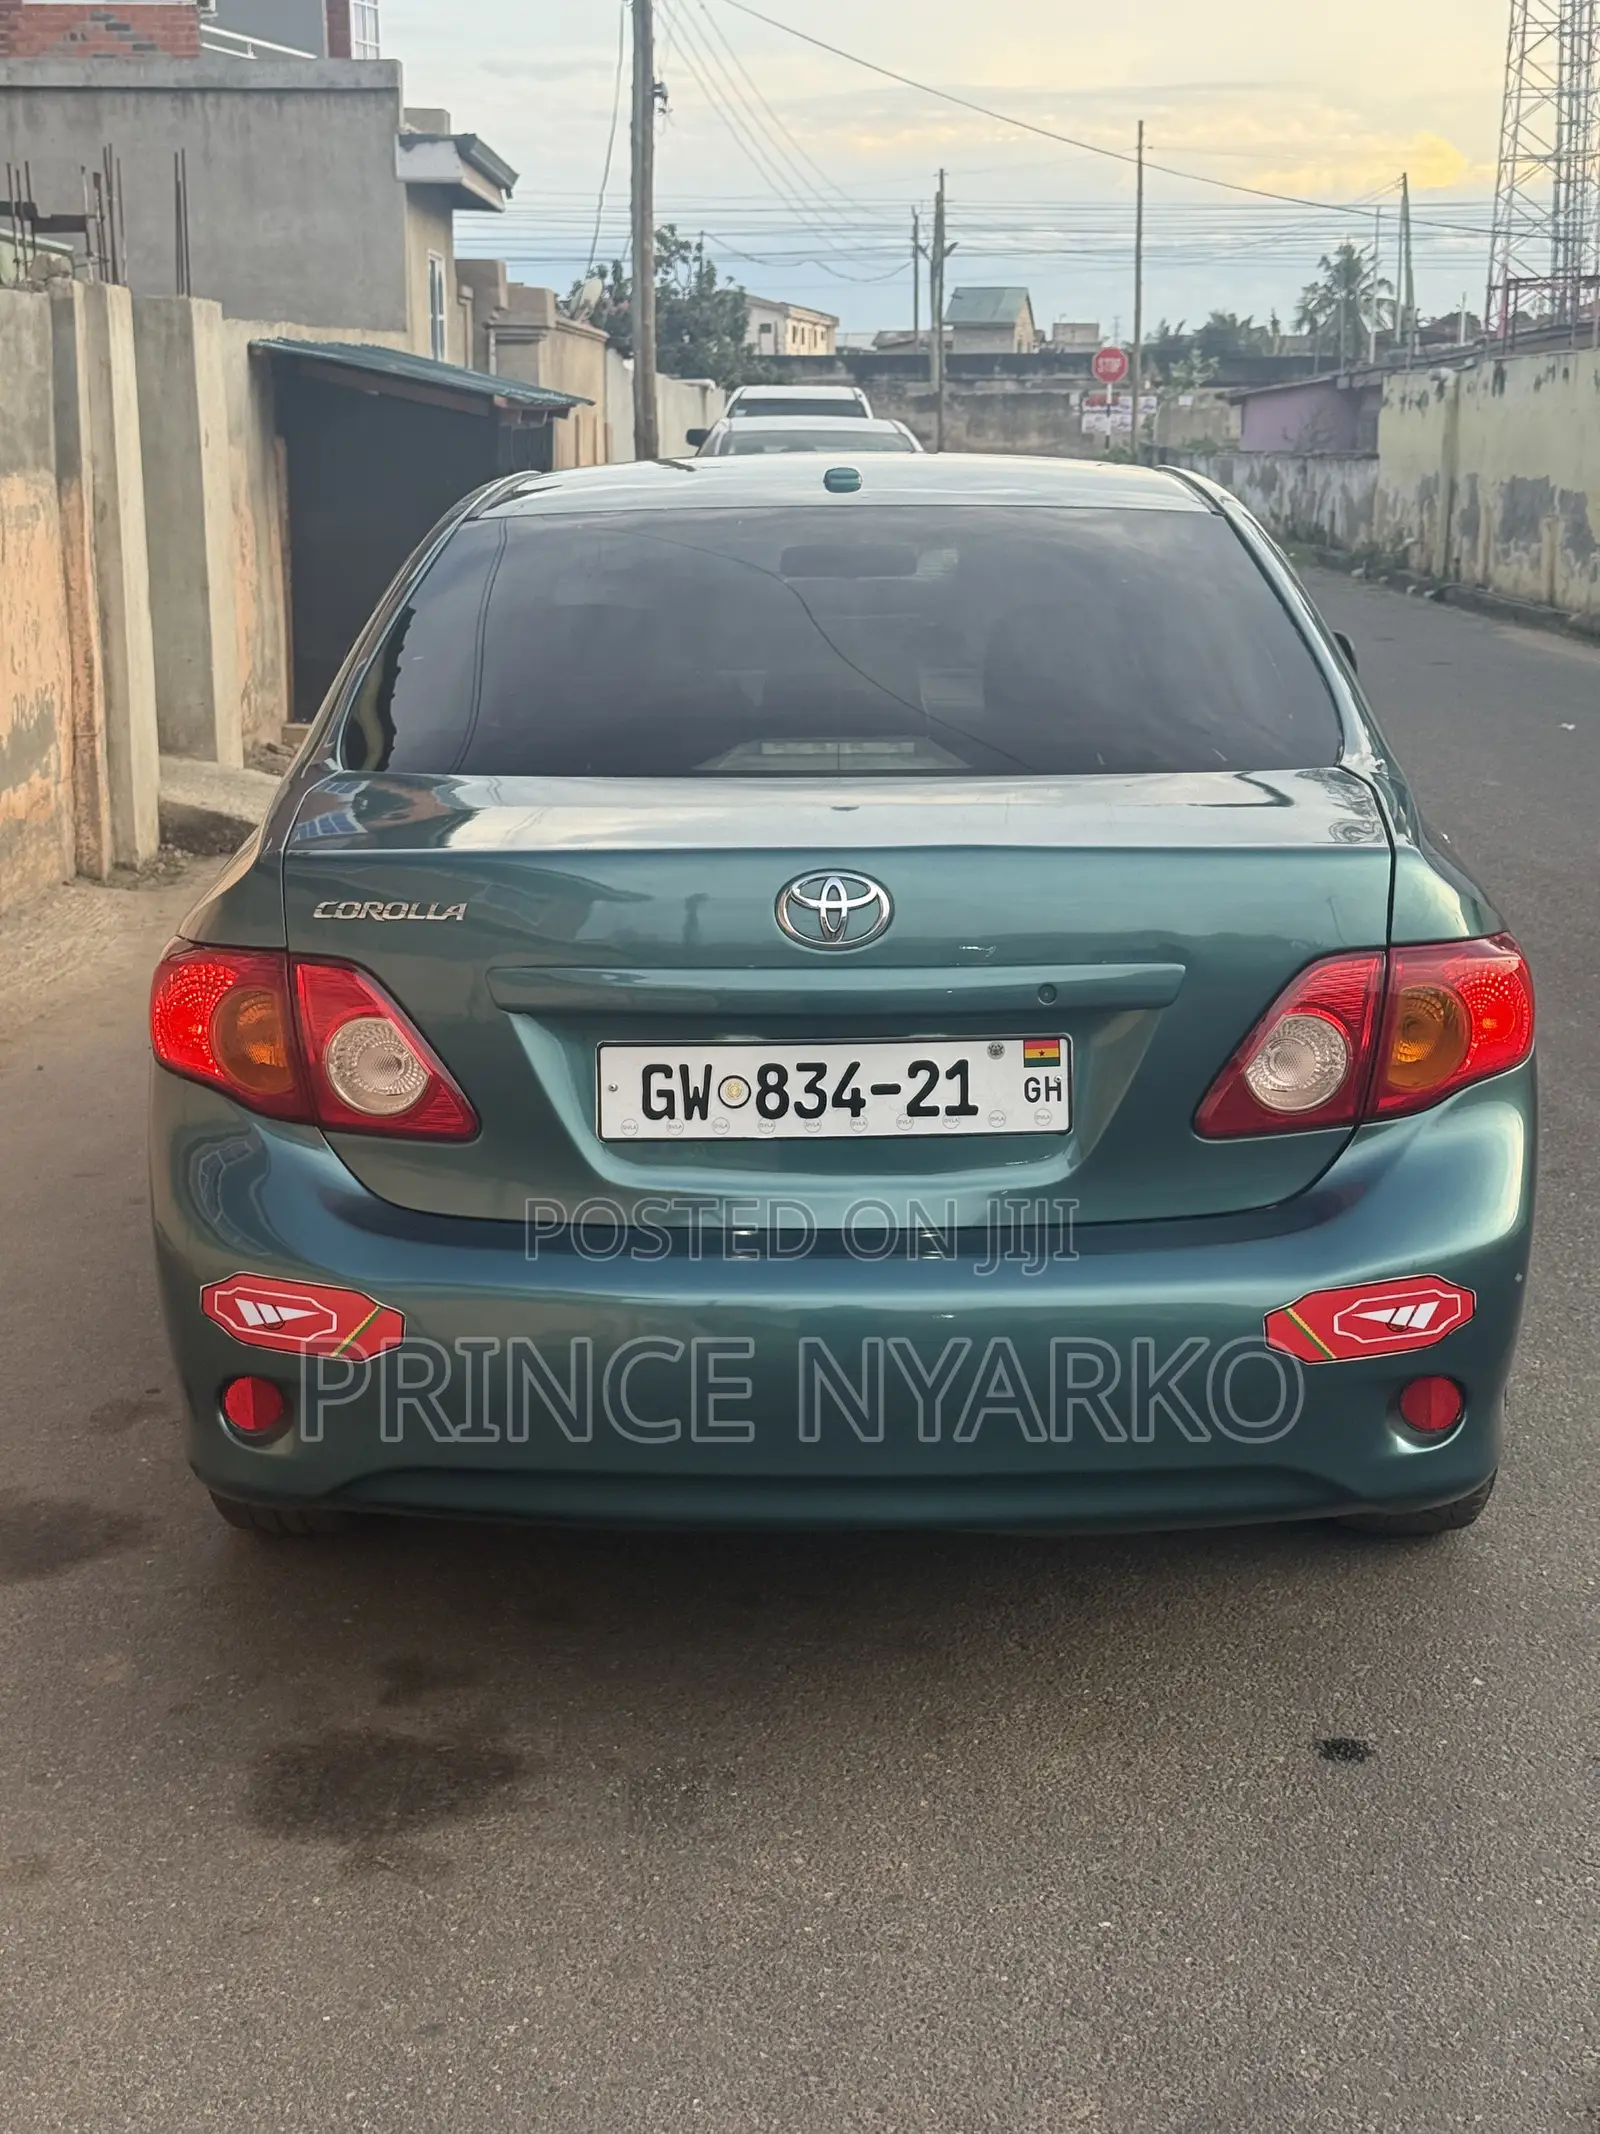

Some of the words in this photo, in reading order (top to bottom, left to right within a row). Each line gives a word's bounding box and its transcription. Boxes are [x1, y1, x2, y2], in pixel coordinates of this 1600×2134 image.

[1097, 356, 1121, 373] STOP
[313, 901, 467, 921] COROLLA
[642, 1064, 712, 1120] GW
[756, 1059, 979, 1119] 834-21
[1024, 1076, 1062, 1103] GH
